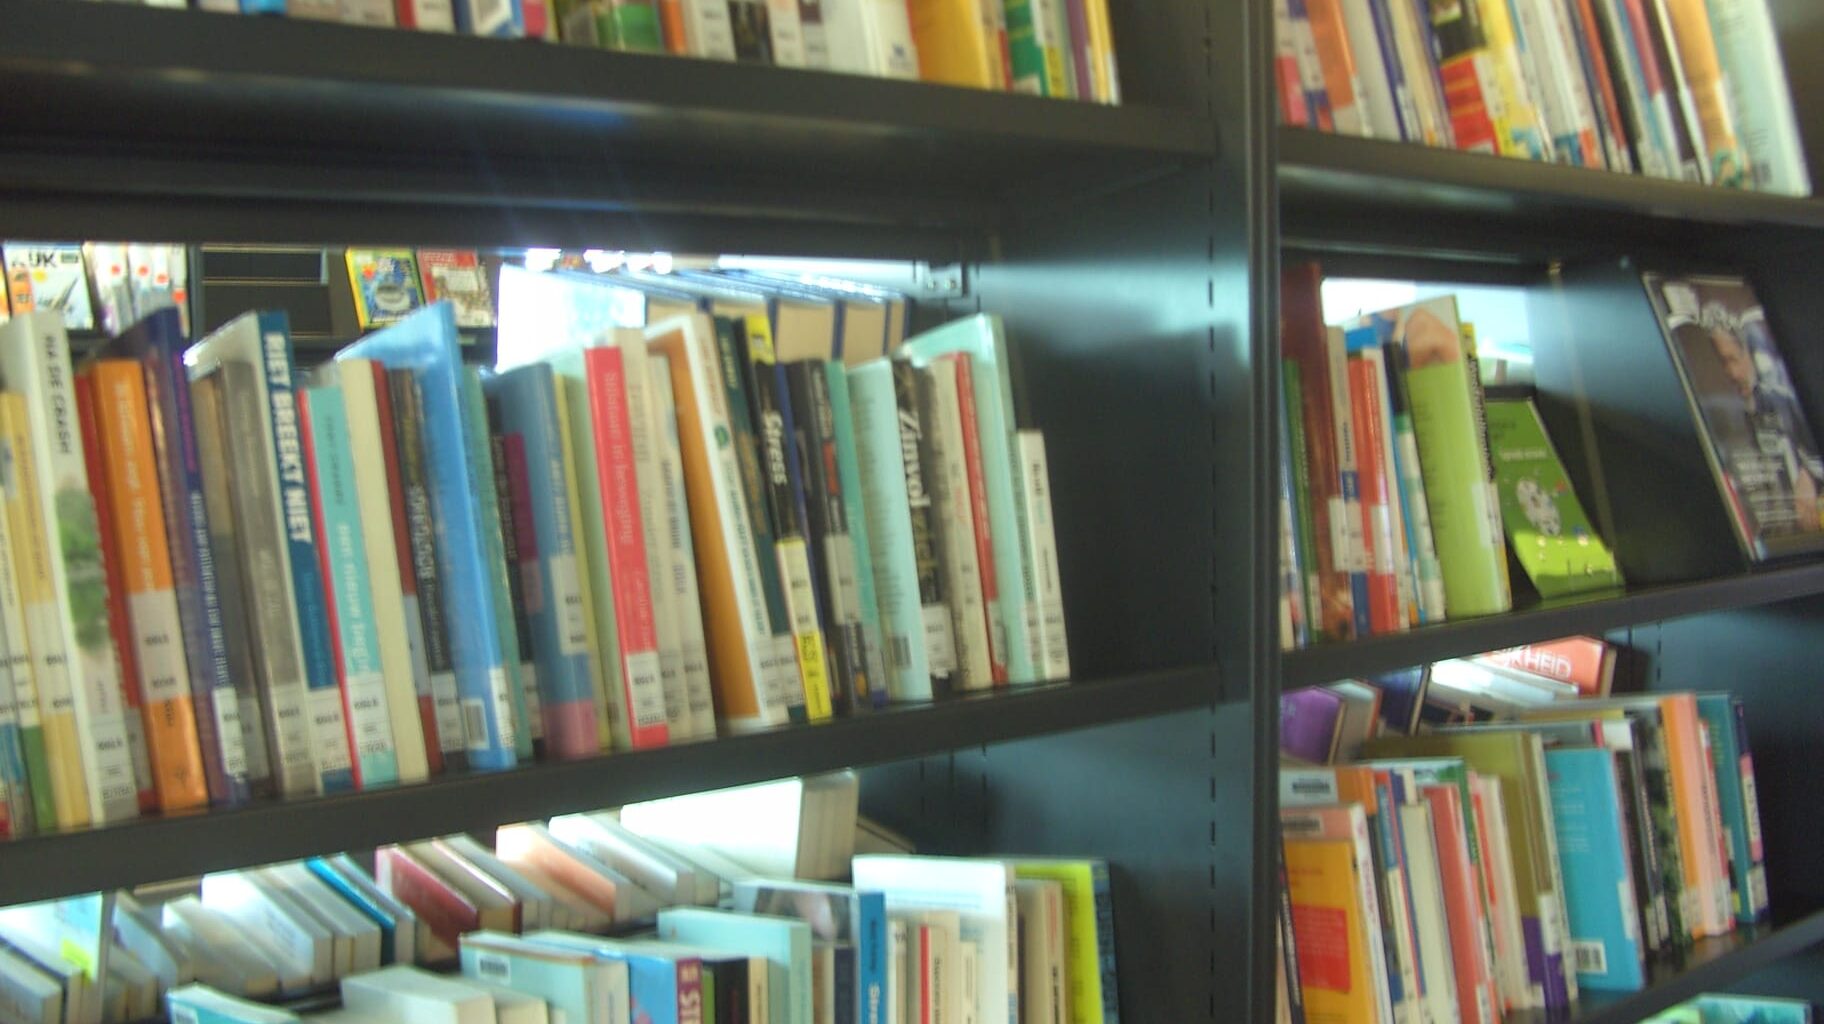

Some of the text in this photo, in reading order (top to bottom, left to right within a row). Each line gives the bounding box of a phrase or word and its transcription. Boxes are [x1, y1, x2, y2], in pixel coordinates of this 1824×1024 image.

[53, 392, 72, 455] CRASH
[271, 388, 303, 485] BREEKT
[764, 411, 788, 485] Stress
[899, 408, 930, 507] Zinvol
[286, 491, 313, 545] NIET
